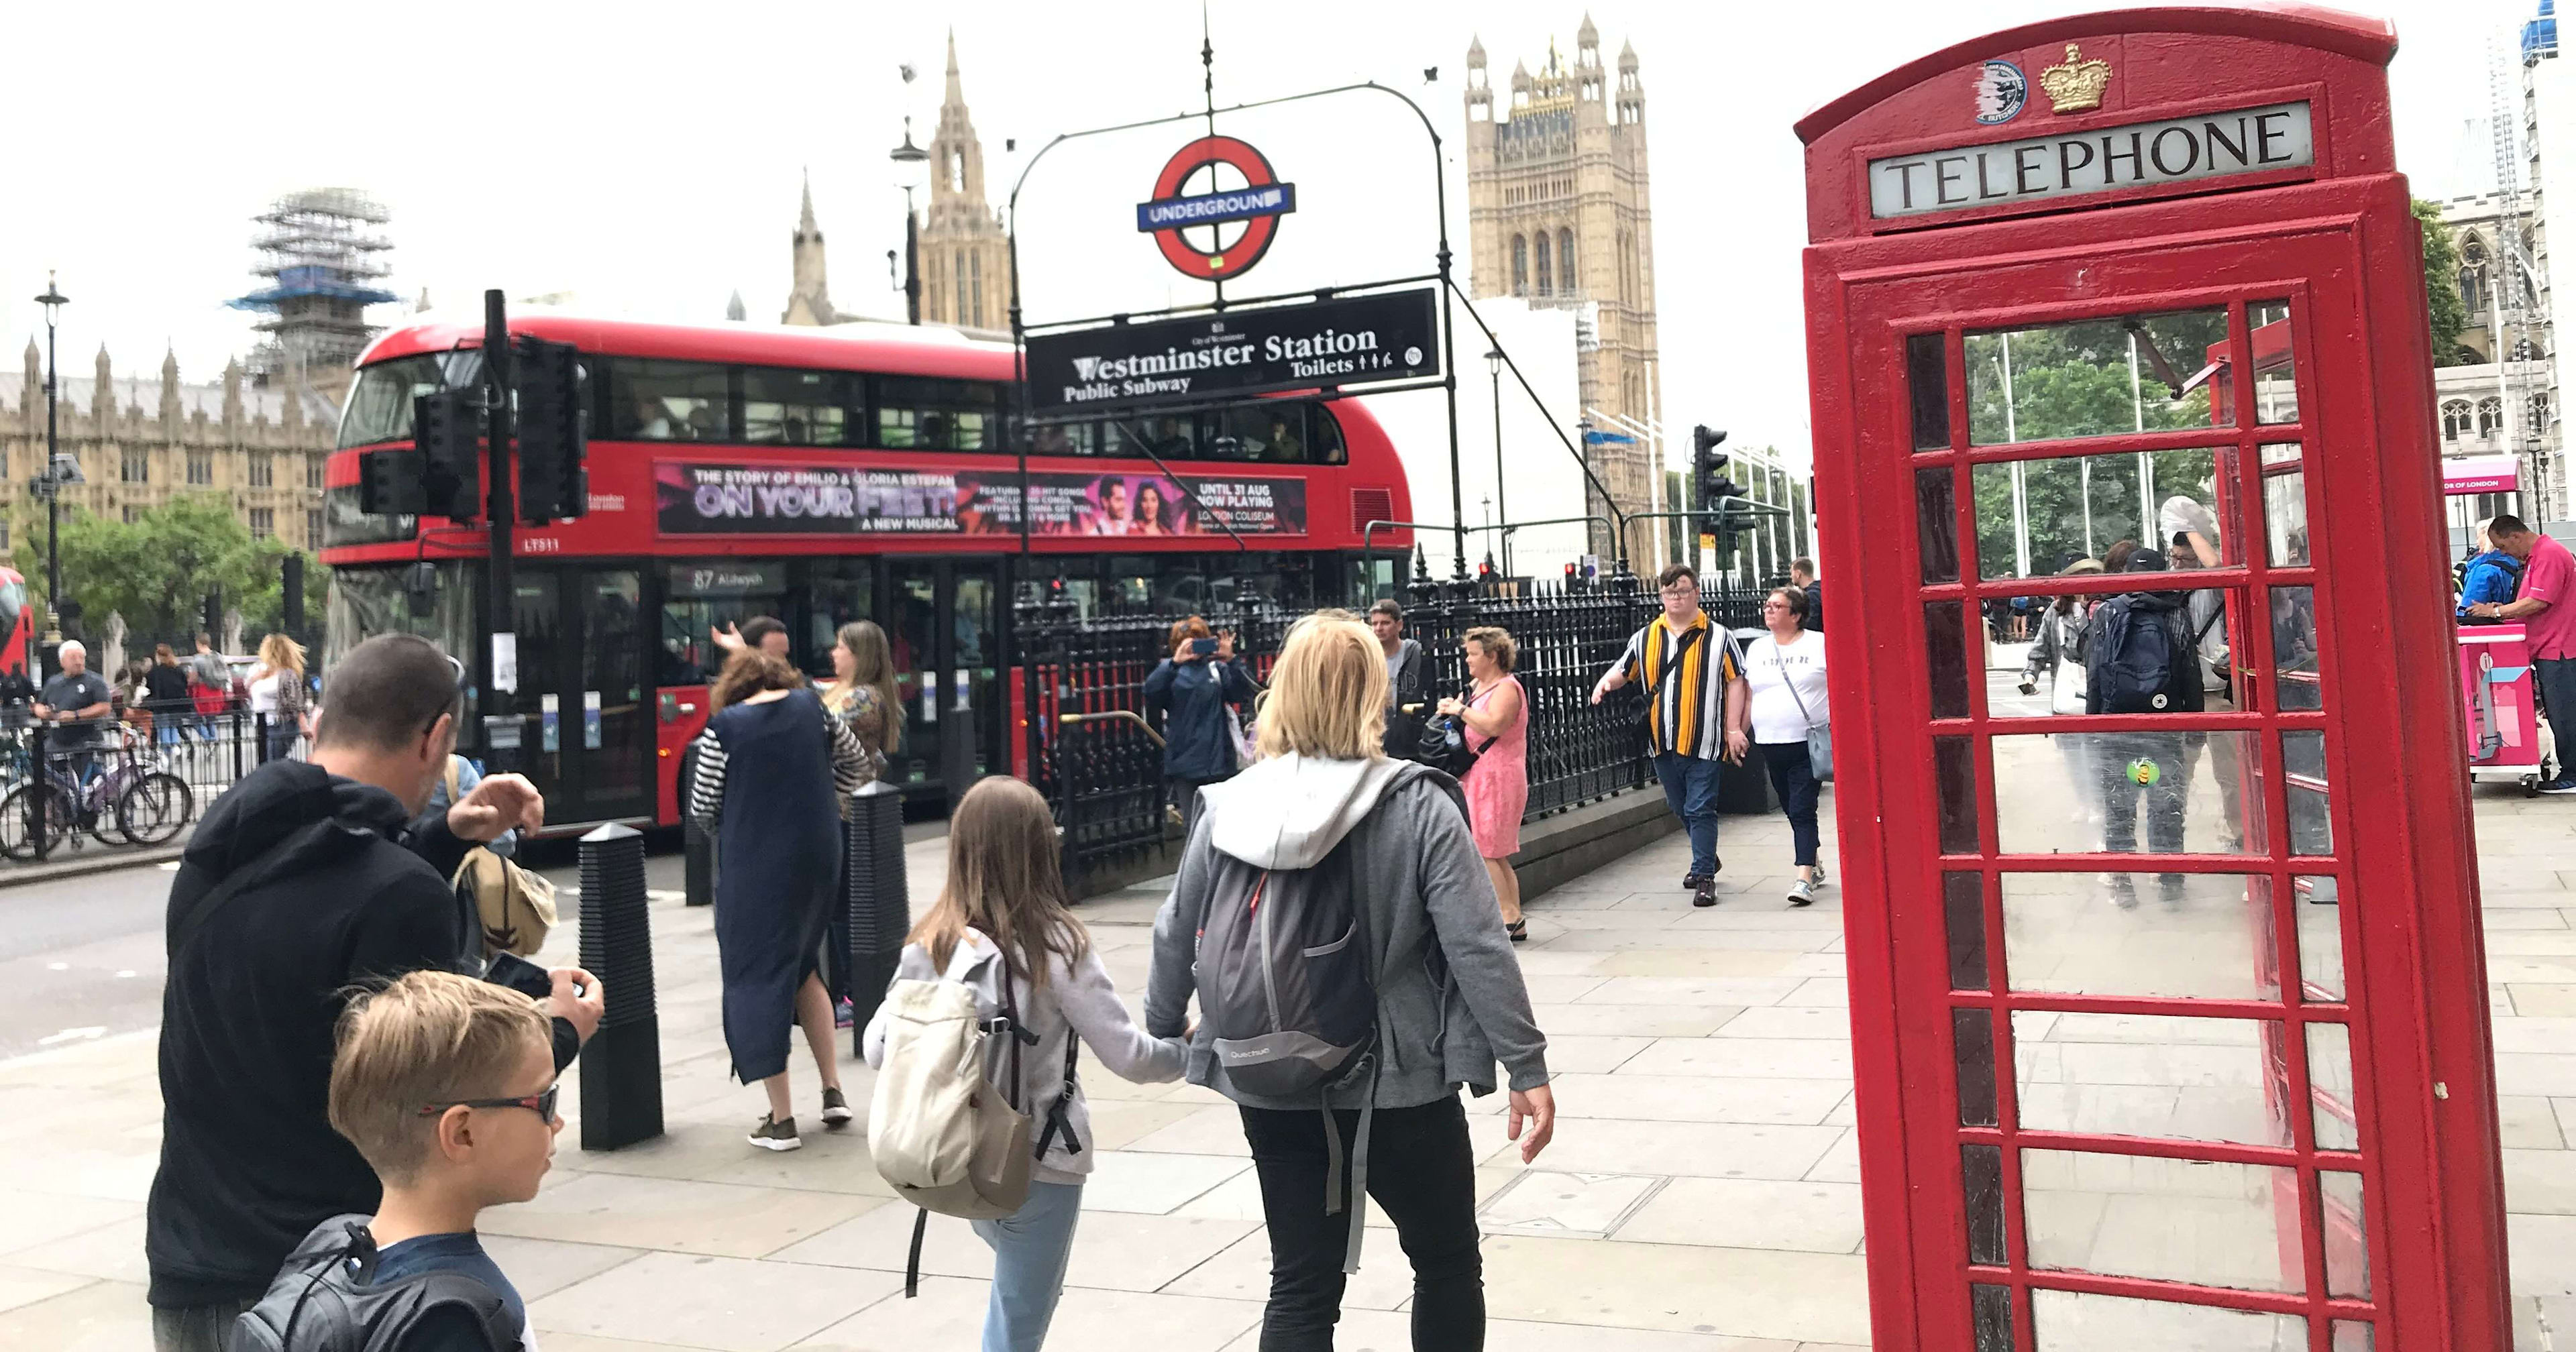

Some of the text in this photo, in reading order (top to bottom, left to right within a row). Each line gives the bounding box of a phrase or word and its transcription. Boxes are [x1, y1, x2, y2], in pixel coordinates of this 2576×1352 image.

[1884, 111, 2293, 209] TELEPHONE
[1072, 329, 1379, 382] Westminster Station
[1291, 359, 1354, 378] Toilets
[1063, 378, 1191, 402] Public Subway
[694, 469, 955, 488] THE STORY OF EMILIO & GLORIA ESTEFAN
[1199, 483, 1270, 496] UNTIL 31 AUG
[695, 484, 956, 518] ON YOUR FEET!
[1197, 496, 1273, 508] NOW PLAYING
[861, 517, 959, 531] A NEW MUSICAL
[1235, 511, 1274, 521] COLISEUM
[524, 539, 559, 553] LT511
[694, 569, 714, 589] 87
